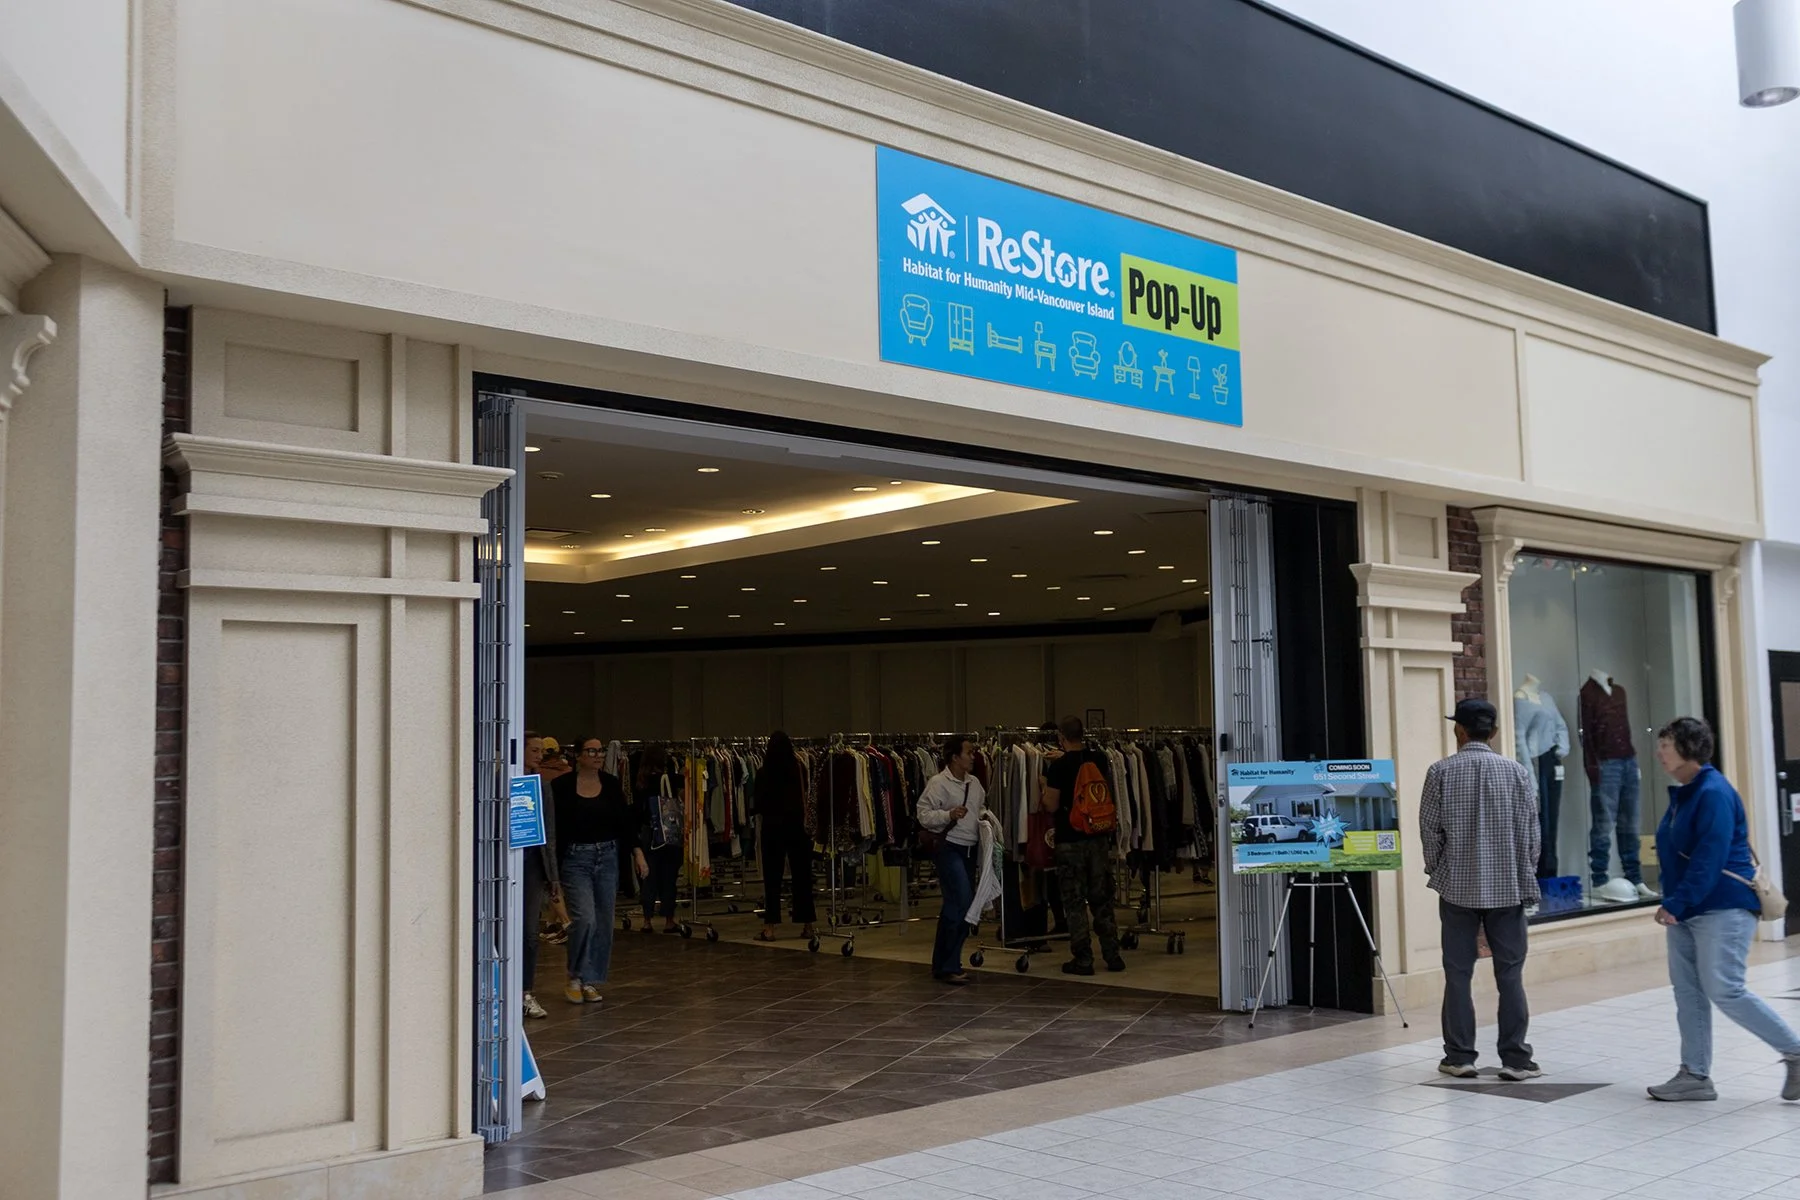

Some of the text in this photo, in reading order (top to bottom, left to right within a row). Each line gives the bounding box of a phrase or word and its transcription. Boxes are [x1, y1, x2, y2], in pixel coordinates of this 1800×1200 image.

[978, 216, 1110, 296] ReStore
[903, 257, 1115, 320] Habitat for Humanity Mid-Vancouver Island
[1129, 267, 1221, 341] Pop-Up
[1269, 768, 1295, 776] Humanity
[1328, 772, 1356, 780] Second
[1353, 763, 1370, 771] SOON
